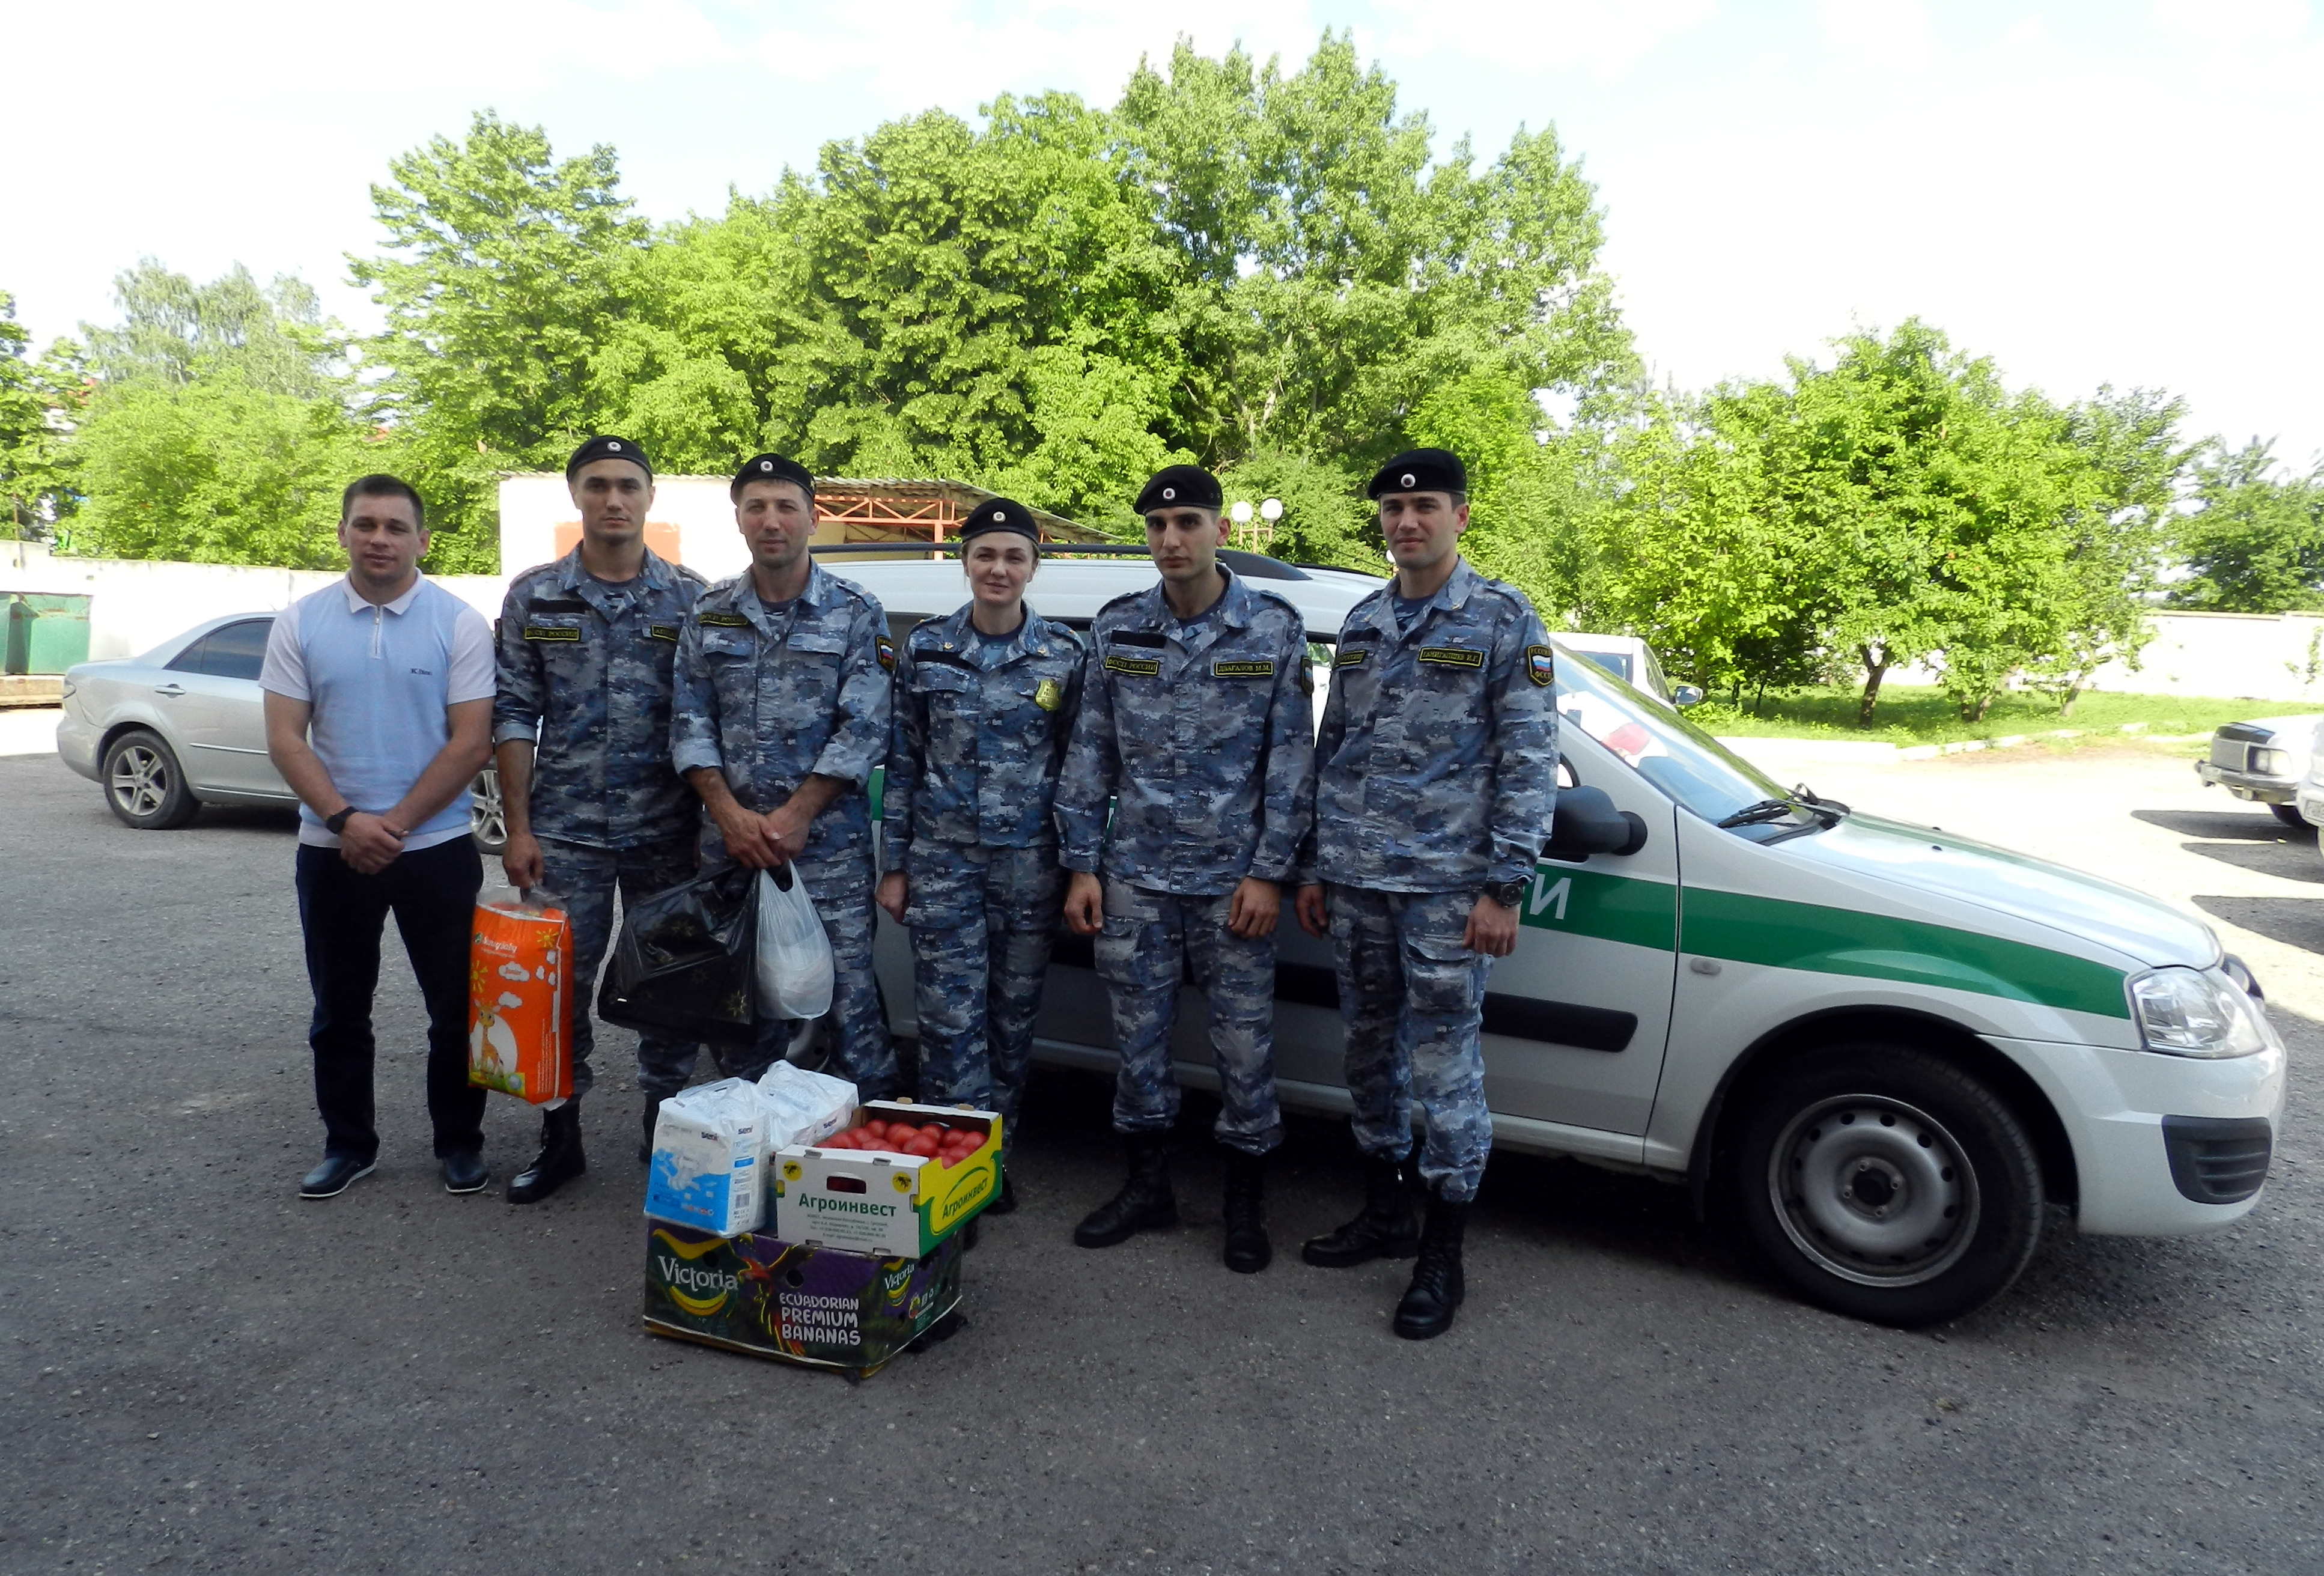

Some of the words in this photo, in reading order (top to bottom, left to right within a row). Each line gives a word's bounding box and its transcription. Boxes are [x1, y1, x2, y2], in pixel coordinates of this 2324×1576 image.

[1107, 659, 1127, 668] ФССП
[738, 1125, 753, 1135] seni
[799, 1193, 897, 1217] Агроинвест
[942, 1177, 988, 1220] Агроинвест
[658, 1255, 739, 1292] Victoria
[884, 1264, 916, 1289] Victoria
[779, 1292, 859, 1310] ECUADORIAN
[782, 1306, 858, 1328] PREMIUM
[782, 1324, 861, 1346] BANANAS
